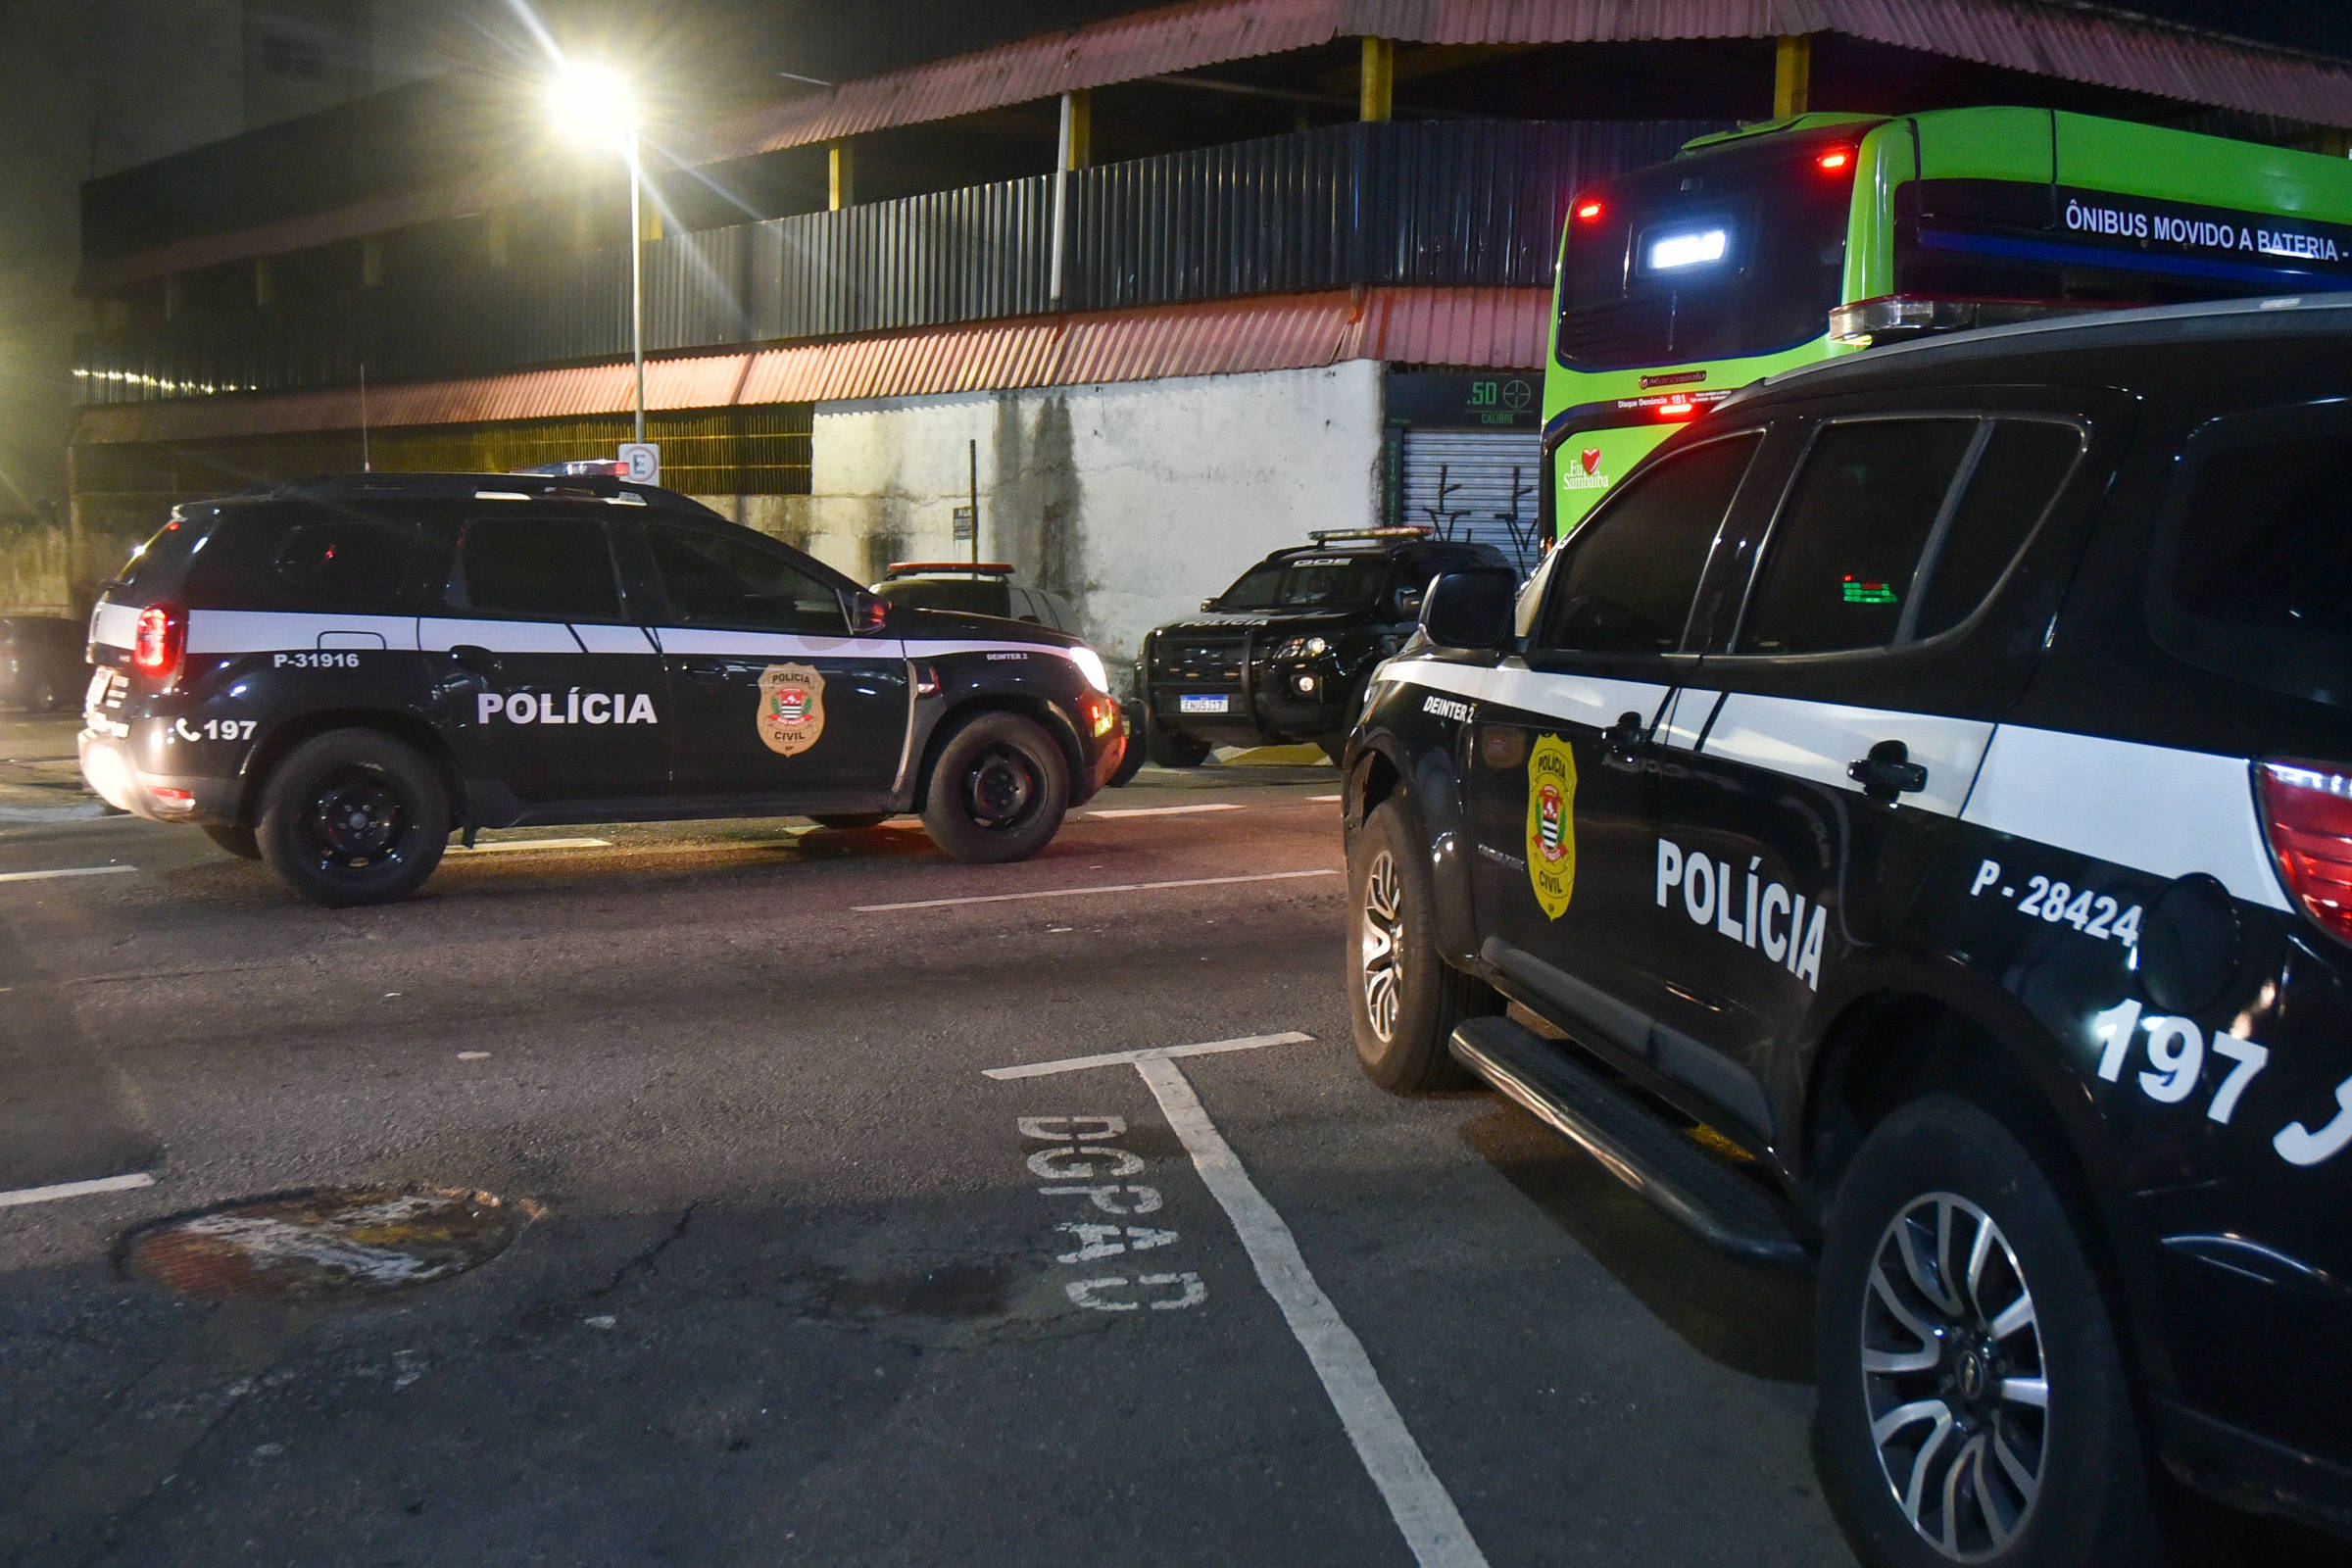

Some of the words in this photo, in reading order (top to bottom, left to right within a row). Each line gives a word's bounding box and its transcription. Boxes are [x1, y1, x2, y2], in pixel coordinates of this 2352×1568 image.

[2066, 199, 2147, 237] ÔNIBUS
[2154, 216, 2234, 248] MOVIDO
[2238, 227, 2253, 252] A
[2257, 230, 2339, 262] BATERIA
[1671, 394, 1687, 404] 181
[1482, 414, 1514, 424] CALIBRE
[633, 454, 646, 474] E
[1570, 460, 1583, 477] Eu
[273, 653, 360, 668] P-31916
[477, 687, 659, 724] POLÍCIA
[1423, 696, 1468, 722] DEINTER
[1466, 706, 1475, 724] 2
[203, 718, 258, 741] 197
[774, 731, 806, 741] CIVIL
[1539, 869, 1562, 894] CIVIL
[1656, 838, 1827, 993] POLÍCIA
[2094, 998, 2269, 1125] 197
